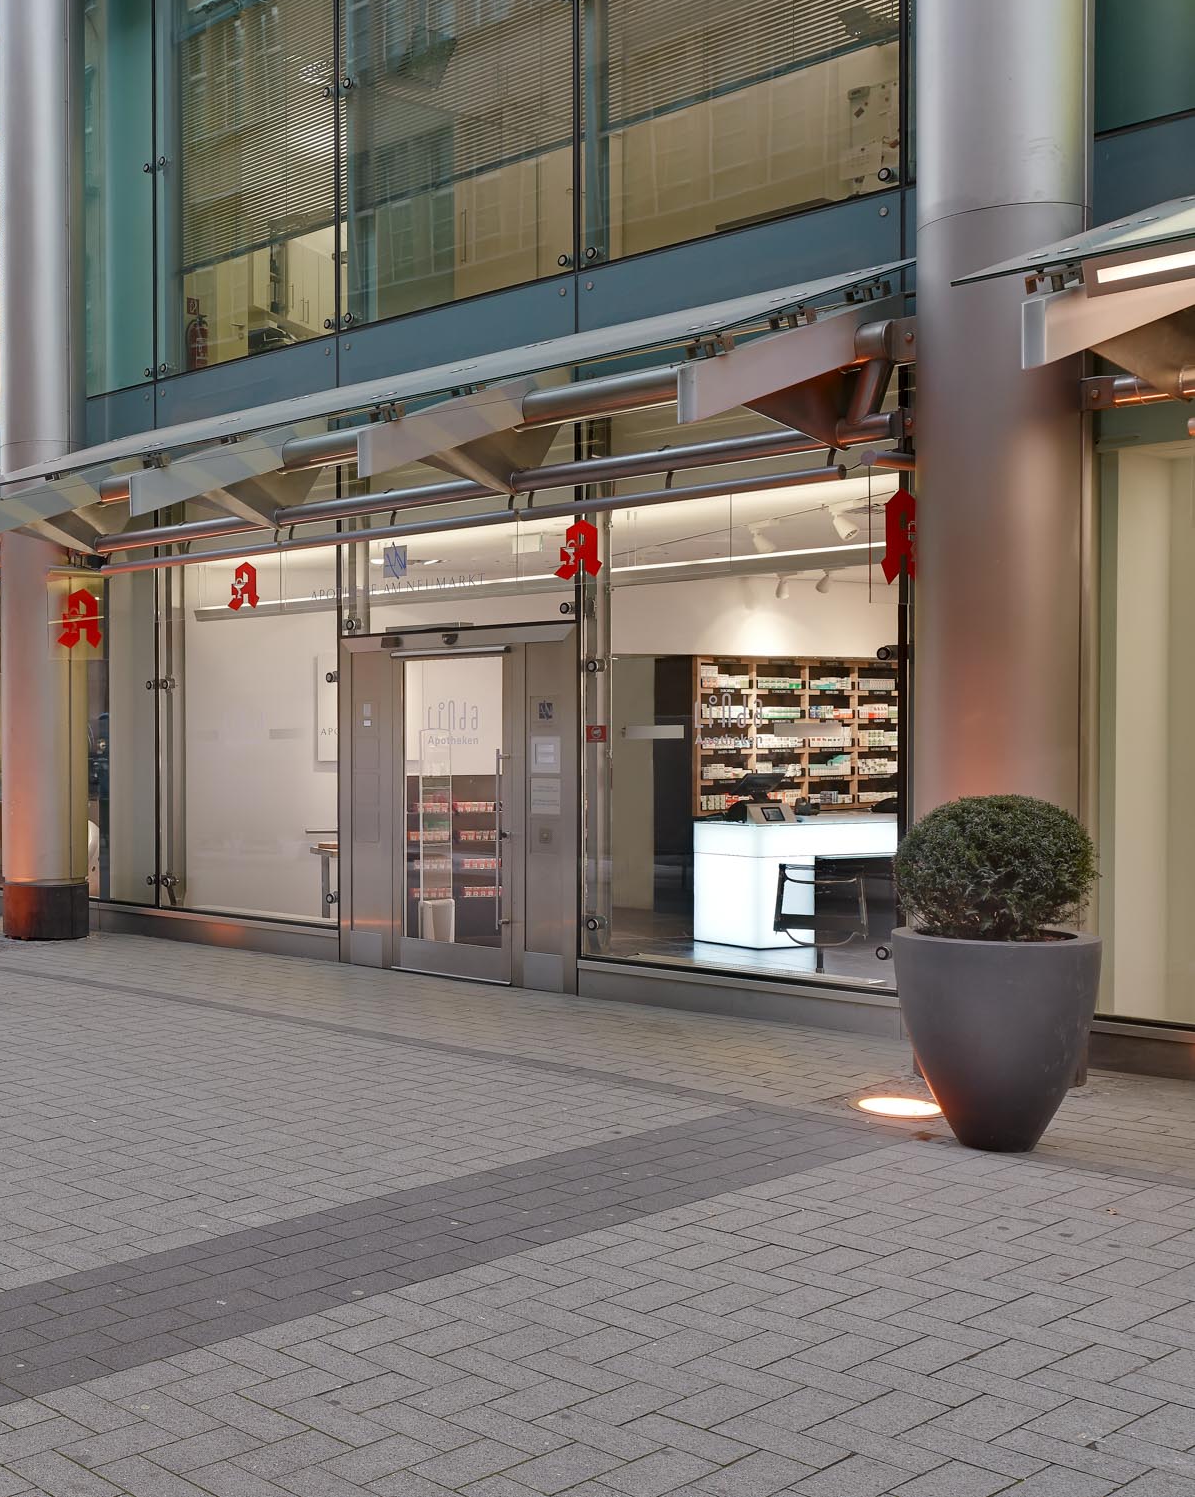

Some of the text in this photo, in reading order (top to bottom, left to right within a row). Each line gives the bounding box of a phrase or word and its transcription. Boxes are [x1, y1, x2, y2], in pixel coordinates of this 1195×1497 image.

[384, 580, 402, 594] AM
[406, 572, 486, 592] NEUMARKT
[427, 736, 479, 746] Apotheken
[695, 734, 763, 746] Apotheken
